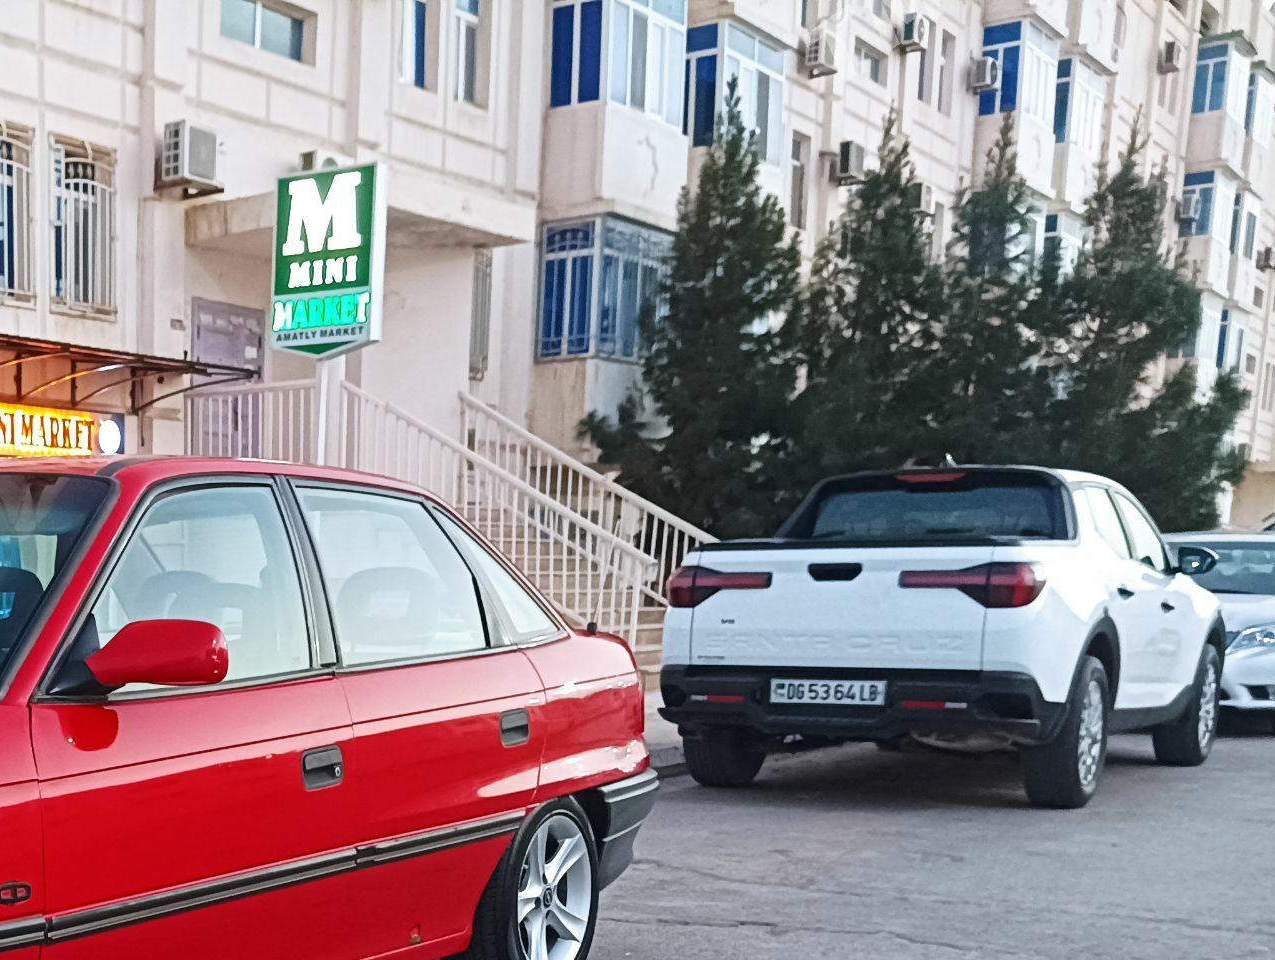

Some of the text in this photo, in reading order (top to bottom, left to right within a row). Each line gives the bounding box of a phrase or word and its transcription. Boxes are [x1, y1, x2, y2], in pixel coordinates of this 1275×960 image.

[282, 171, 362, 257] M
[288, 255, 358, 289] MINI
[272, 292, 371, 332] MARKET
[276, 325, 364, 342] AMATLY MARKET
[21, 414, 95, 450] MARKET
